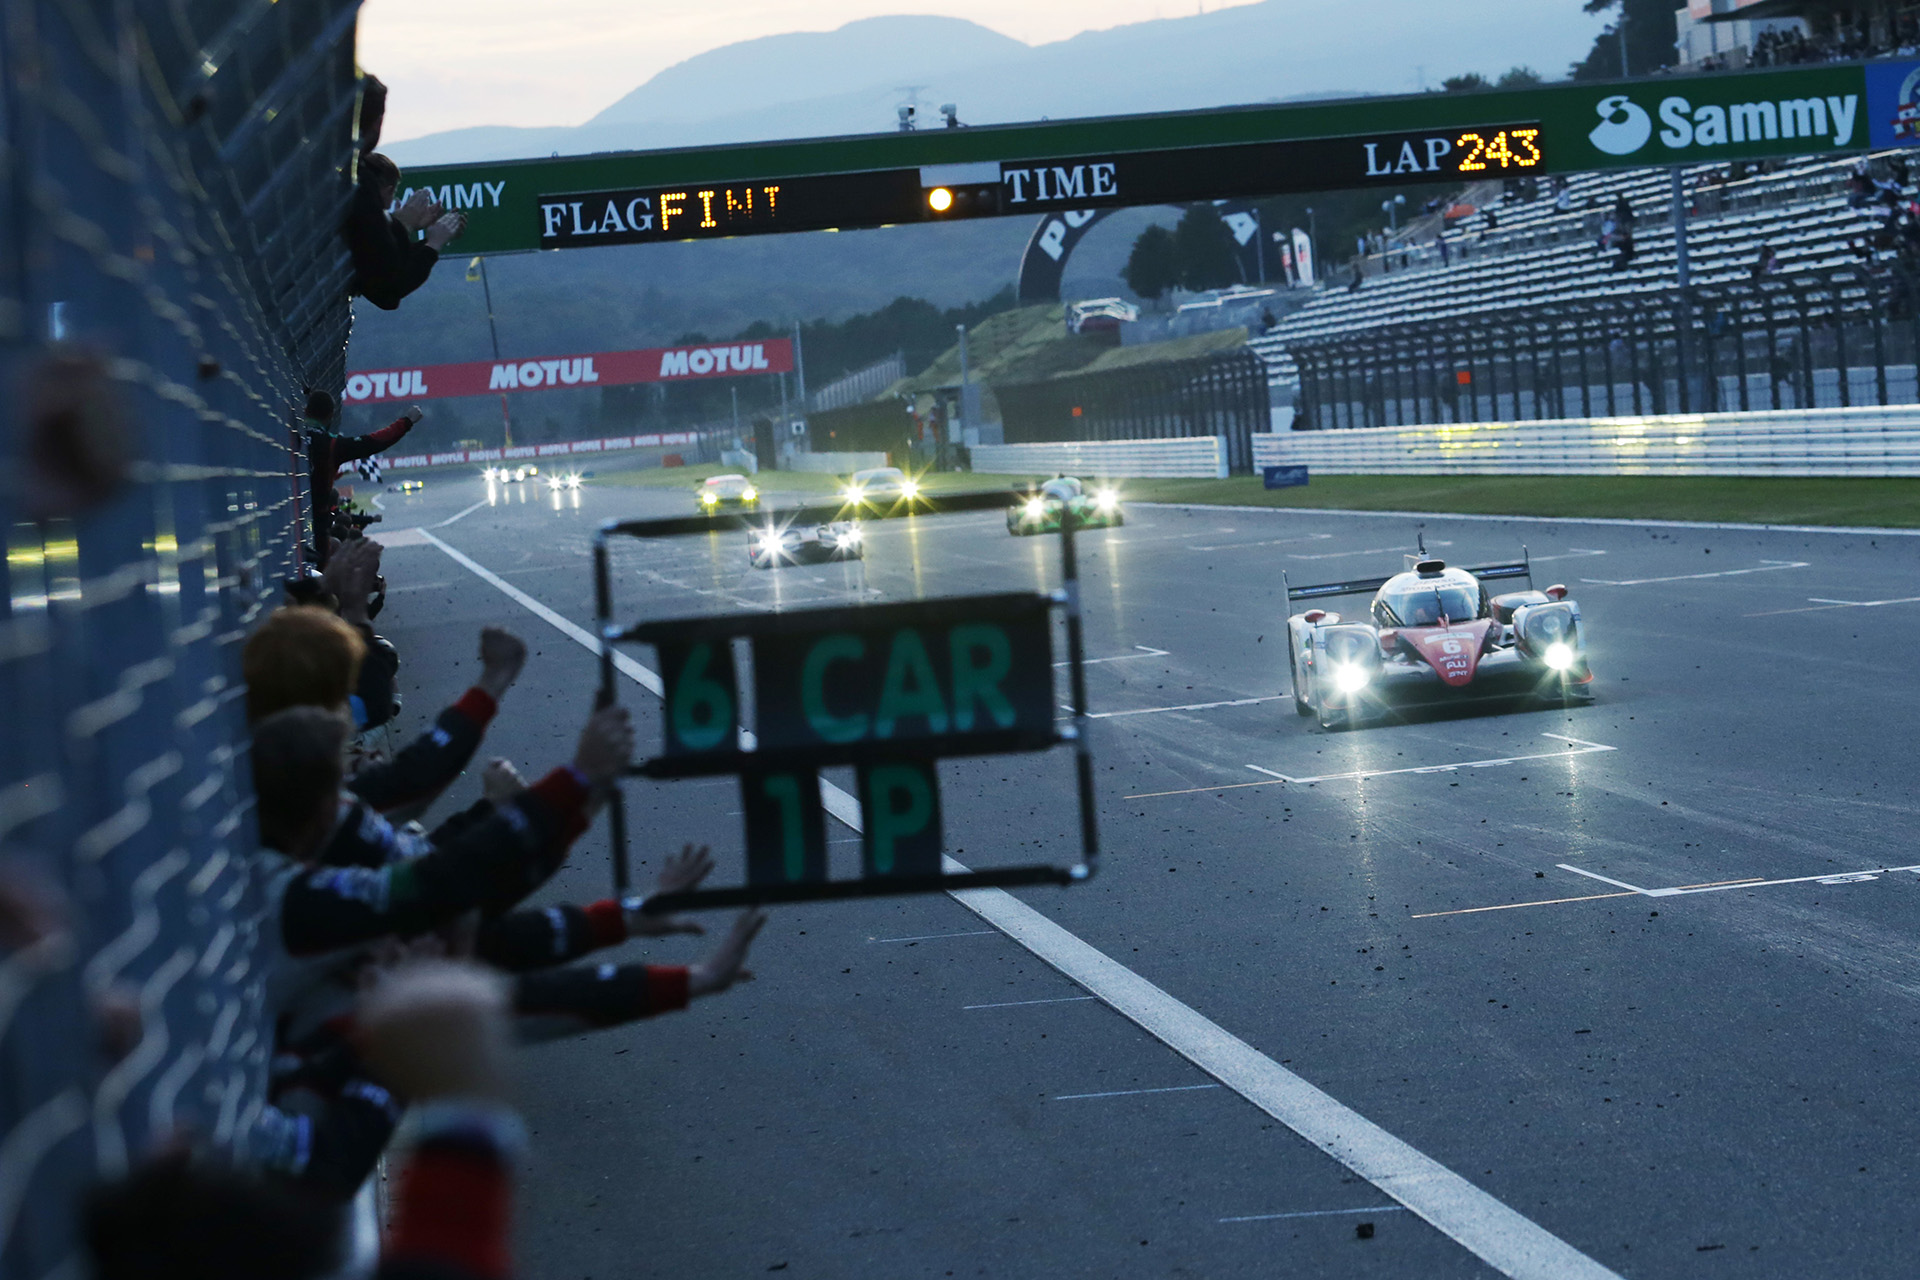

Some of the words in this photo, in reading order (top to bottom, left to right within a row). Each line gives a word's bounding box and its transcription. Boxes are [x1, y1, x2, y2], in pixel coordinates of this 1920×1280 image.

[1658, 95, 1858, 148] Sammy
[1364, 138, 1451, 176] LAP
[1457, 128, 1541, 172] 243
[388, 181, 506, 213] AMMY
[1004, 163, 1117, 203] TIME
[541, 197, 654, 237] FLAG
[490, 358, 598, 390] MOTUL
[660, 345, 768, 377] MOTUL
[341, 370, 427, 400] OTUL
[394, 455, 428, 468] MOTUL
[431, 452, 464, 465] MOTUL
[1442, 640, 1462, 654] 6
[672, 643, 731, 750] 6
[802, 622, 1017, 743] CAR
[763, 774, 804, 881] 1
[868, 763, 933, 874] P
